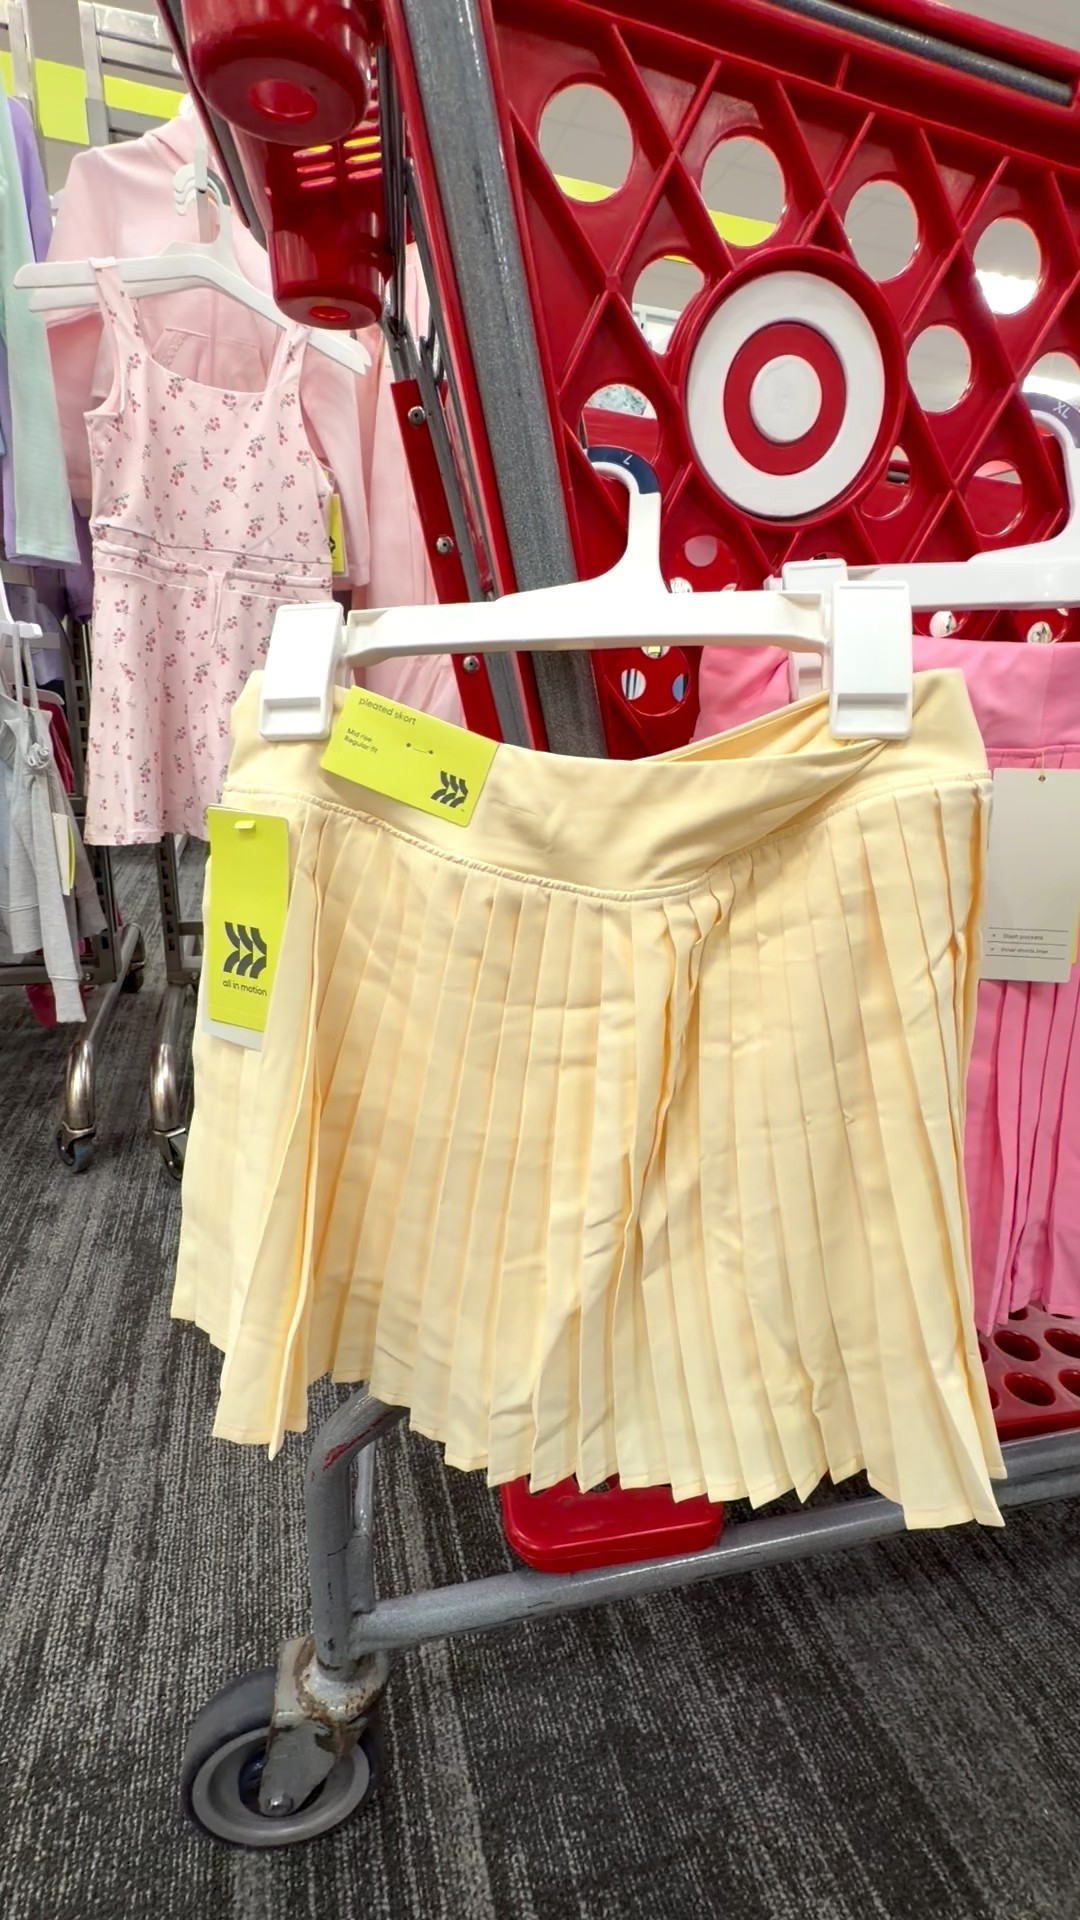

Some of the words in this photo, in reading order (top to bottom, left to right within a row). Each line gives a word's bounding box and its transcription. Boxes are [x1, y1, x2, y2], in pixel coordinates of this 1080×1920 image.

[1053, 401, 1071, 420] XL
[623, 454, 633, 466] L
[358, 698, 394, 716] pleated
[394, 711, 417, 726] skort
[347, 728, 360, 738] Mid
[344, 735, 369, 750] Regular
[370, 745, 379, 754] fit
[222, 979, 232, 988] all
[232, 980, 240, 990] in
[240, 984, 268, 997] motion
